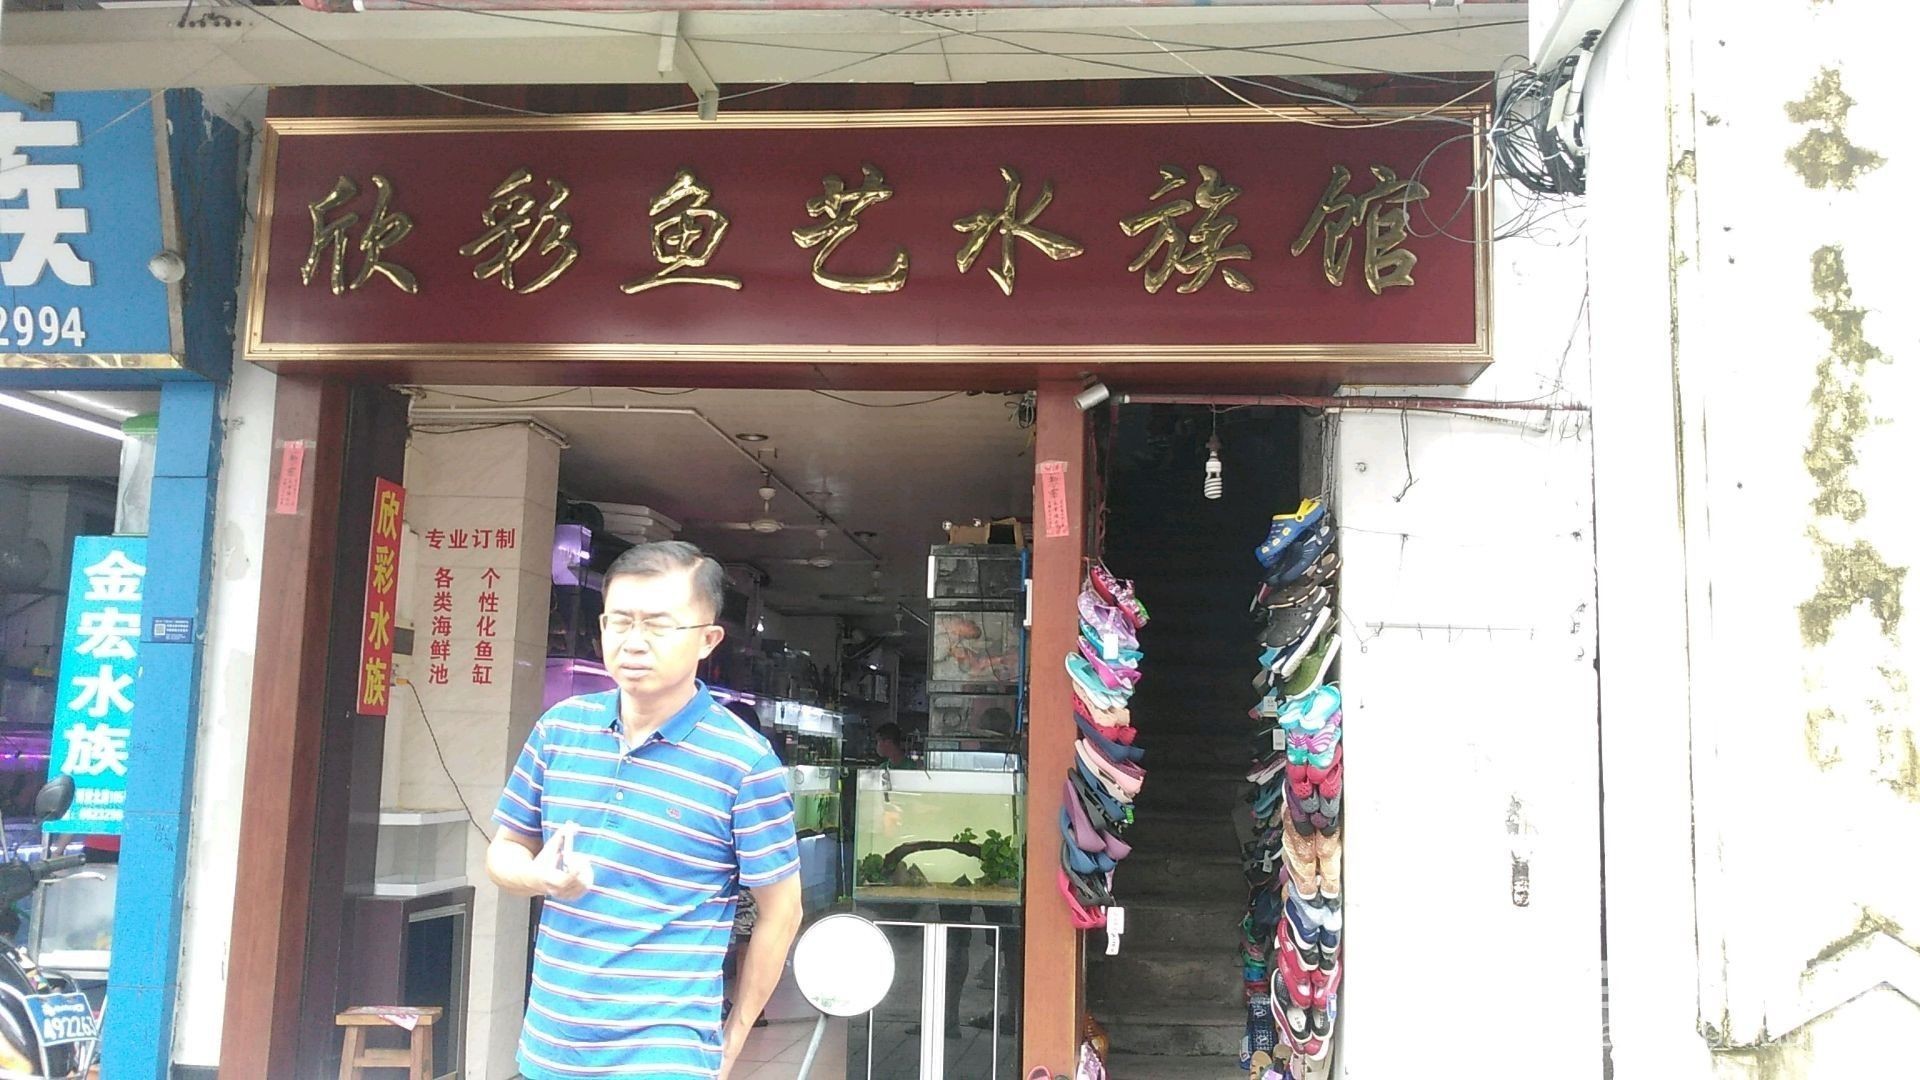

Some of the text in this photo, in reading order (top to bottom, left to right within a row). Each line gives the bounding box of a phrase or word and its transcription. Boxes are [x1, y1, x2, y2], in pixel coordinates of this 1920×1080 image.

[300, 164, 1430, 297] 欣彩鱼艺水族馆
[363, 489, 400, 706] 欣彩水族
[425, 527, 516, 550] 专业订制
[60, 549, 146, 777] 金宏水族
[428, 566, 455, 685] 各类海鲜池
[471, 566, 501, 685] 个性化鱼缸
